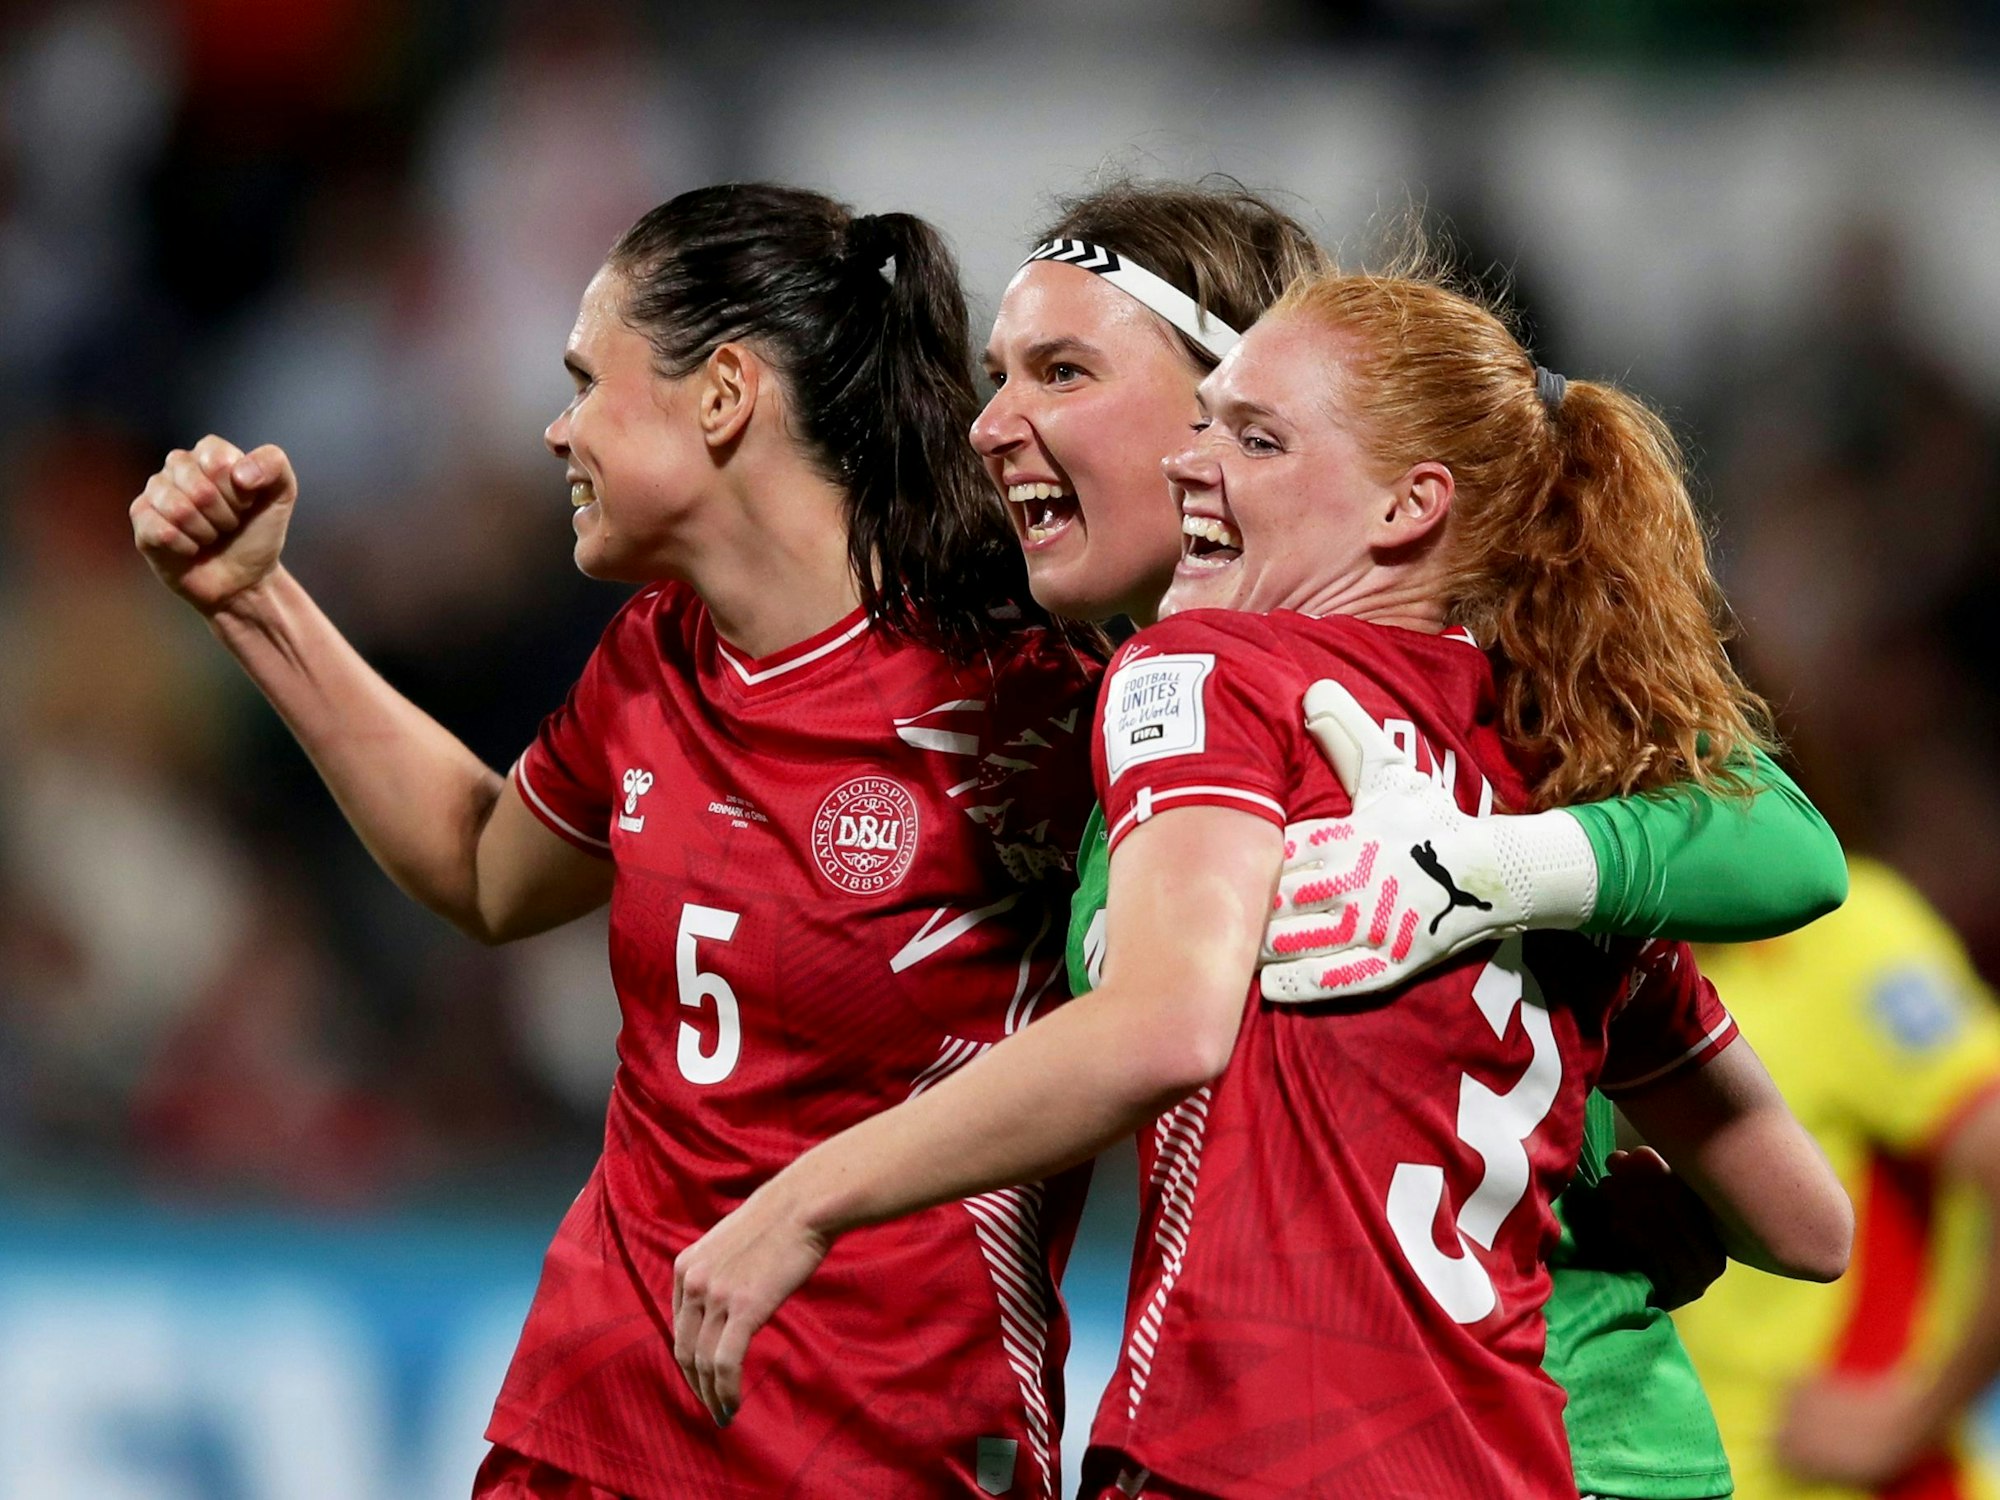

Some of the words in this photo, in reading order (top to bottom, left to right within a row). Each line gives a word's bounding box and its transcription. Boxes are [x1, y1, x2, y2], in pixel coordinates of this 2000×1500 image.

[1122, 682, 1178, 713] UNITES
[1124, 672, 1180, 694] FOOTBALL
[1118, 716, 1136, 732] the
[1139, 698, 1180, 723] World
[1132, 725, 1162, 743] FIFA
[708, 801, 744, 818] DENMARK
[816, 806, 838, 874] DANSK
[890, 816, 915, 877] UNION
[835, 815, 900, 851] DBU
[841, 873, 884, 890] 1889
[676, 903, 740, 1085] 5
[1386, 938, 1562, 1324] 3
